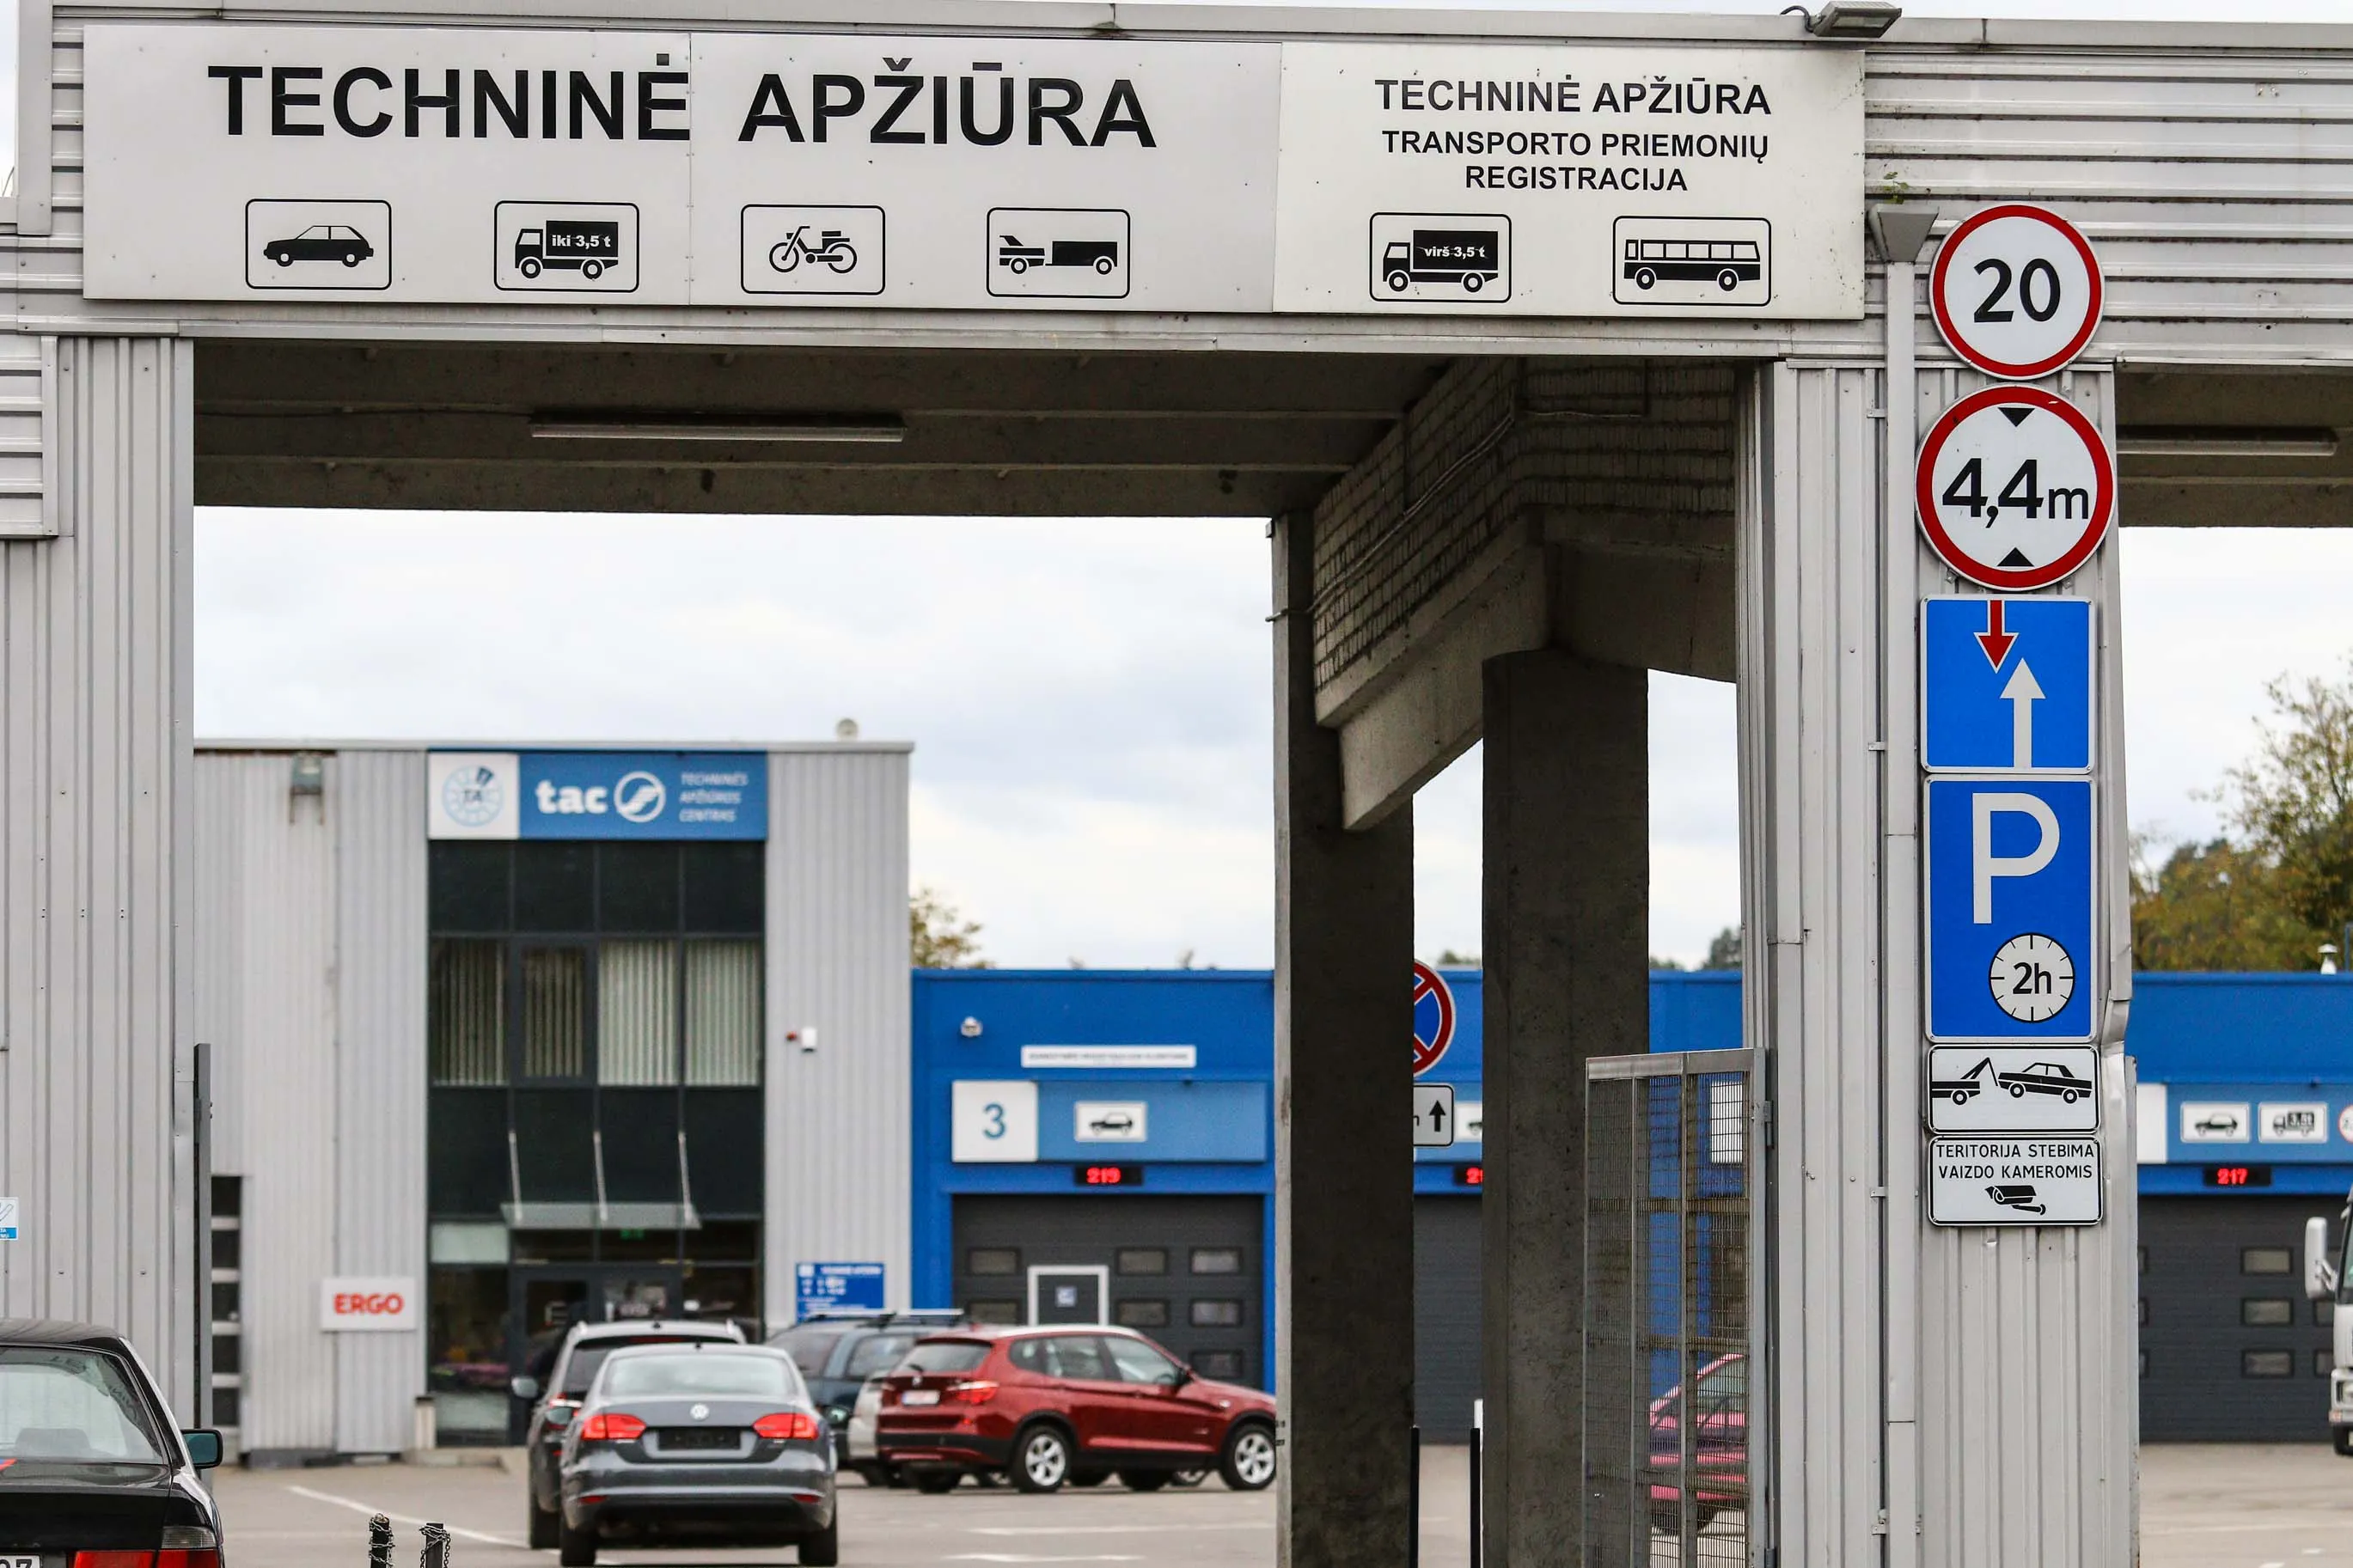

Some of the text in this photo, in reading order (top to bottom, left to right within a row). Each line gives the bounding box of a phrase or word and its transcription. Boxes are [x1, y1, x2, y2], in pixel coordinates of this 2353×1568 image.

[208, 53, 1157, 147] TECHNINĖ APŽIŪRA
[1375, 75, 1772, 115] TECHNINĖ APŽIŪRA
[1382, 130, 1769, 163] TRANSPORTO PRIEMONIŲ
[1466, 165, 1688, 191] REGISTRACIJA
[552, 235, 611, 249] iki 3,5 t
[1424, 246, 1485, 259] virš 3,5 t
[1973, 258, 2061, 322] 20
[535, 779, 608, 815] tac
[1972, 793, 2060, 924] P
[2012, 961, 2052, 995] 2h
[983, 1102, 1005, 1139] 3
[1936, 1144, 2094, 1158] TERITORIJA STEBIMA
[1939, 1165, 2093, 1179] VAIZDO KAMEROMIS
[2217, 1168, 2248, 1185] 217
[333, 1291, 405, 1315] ERGO
